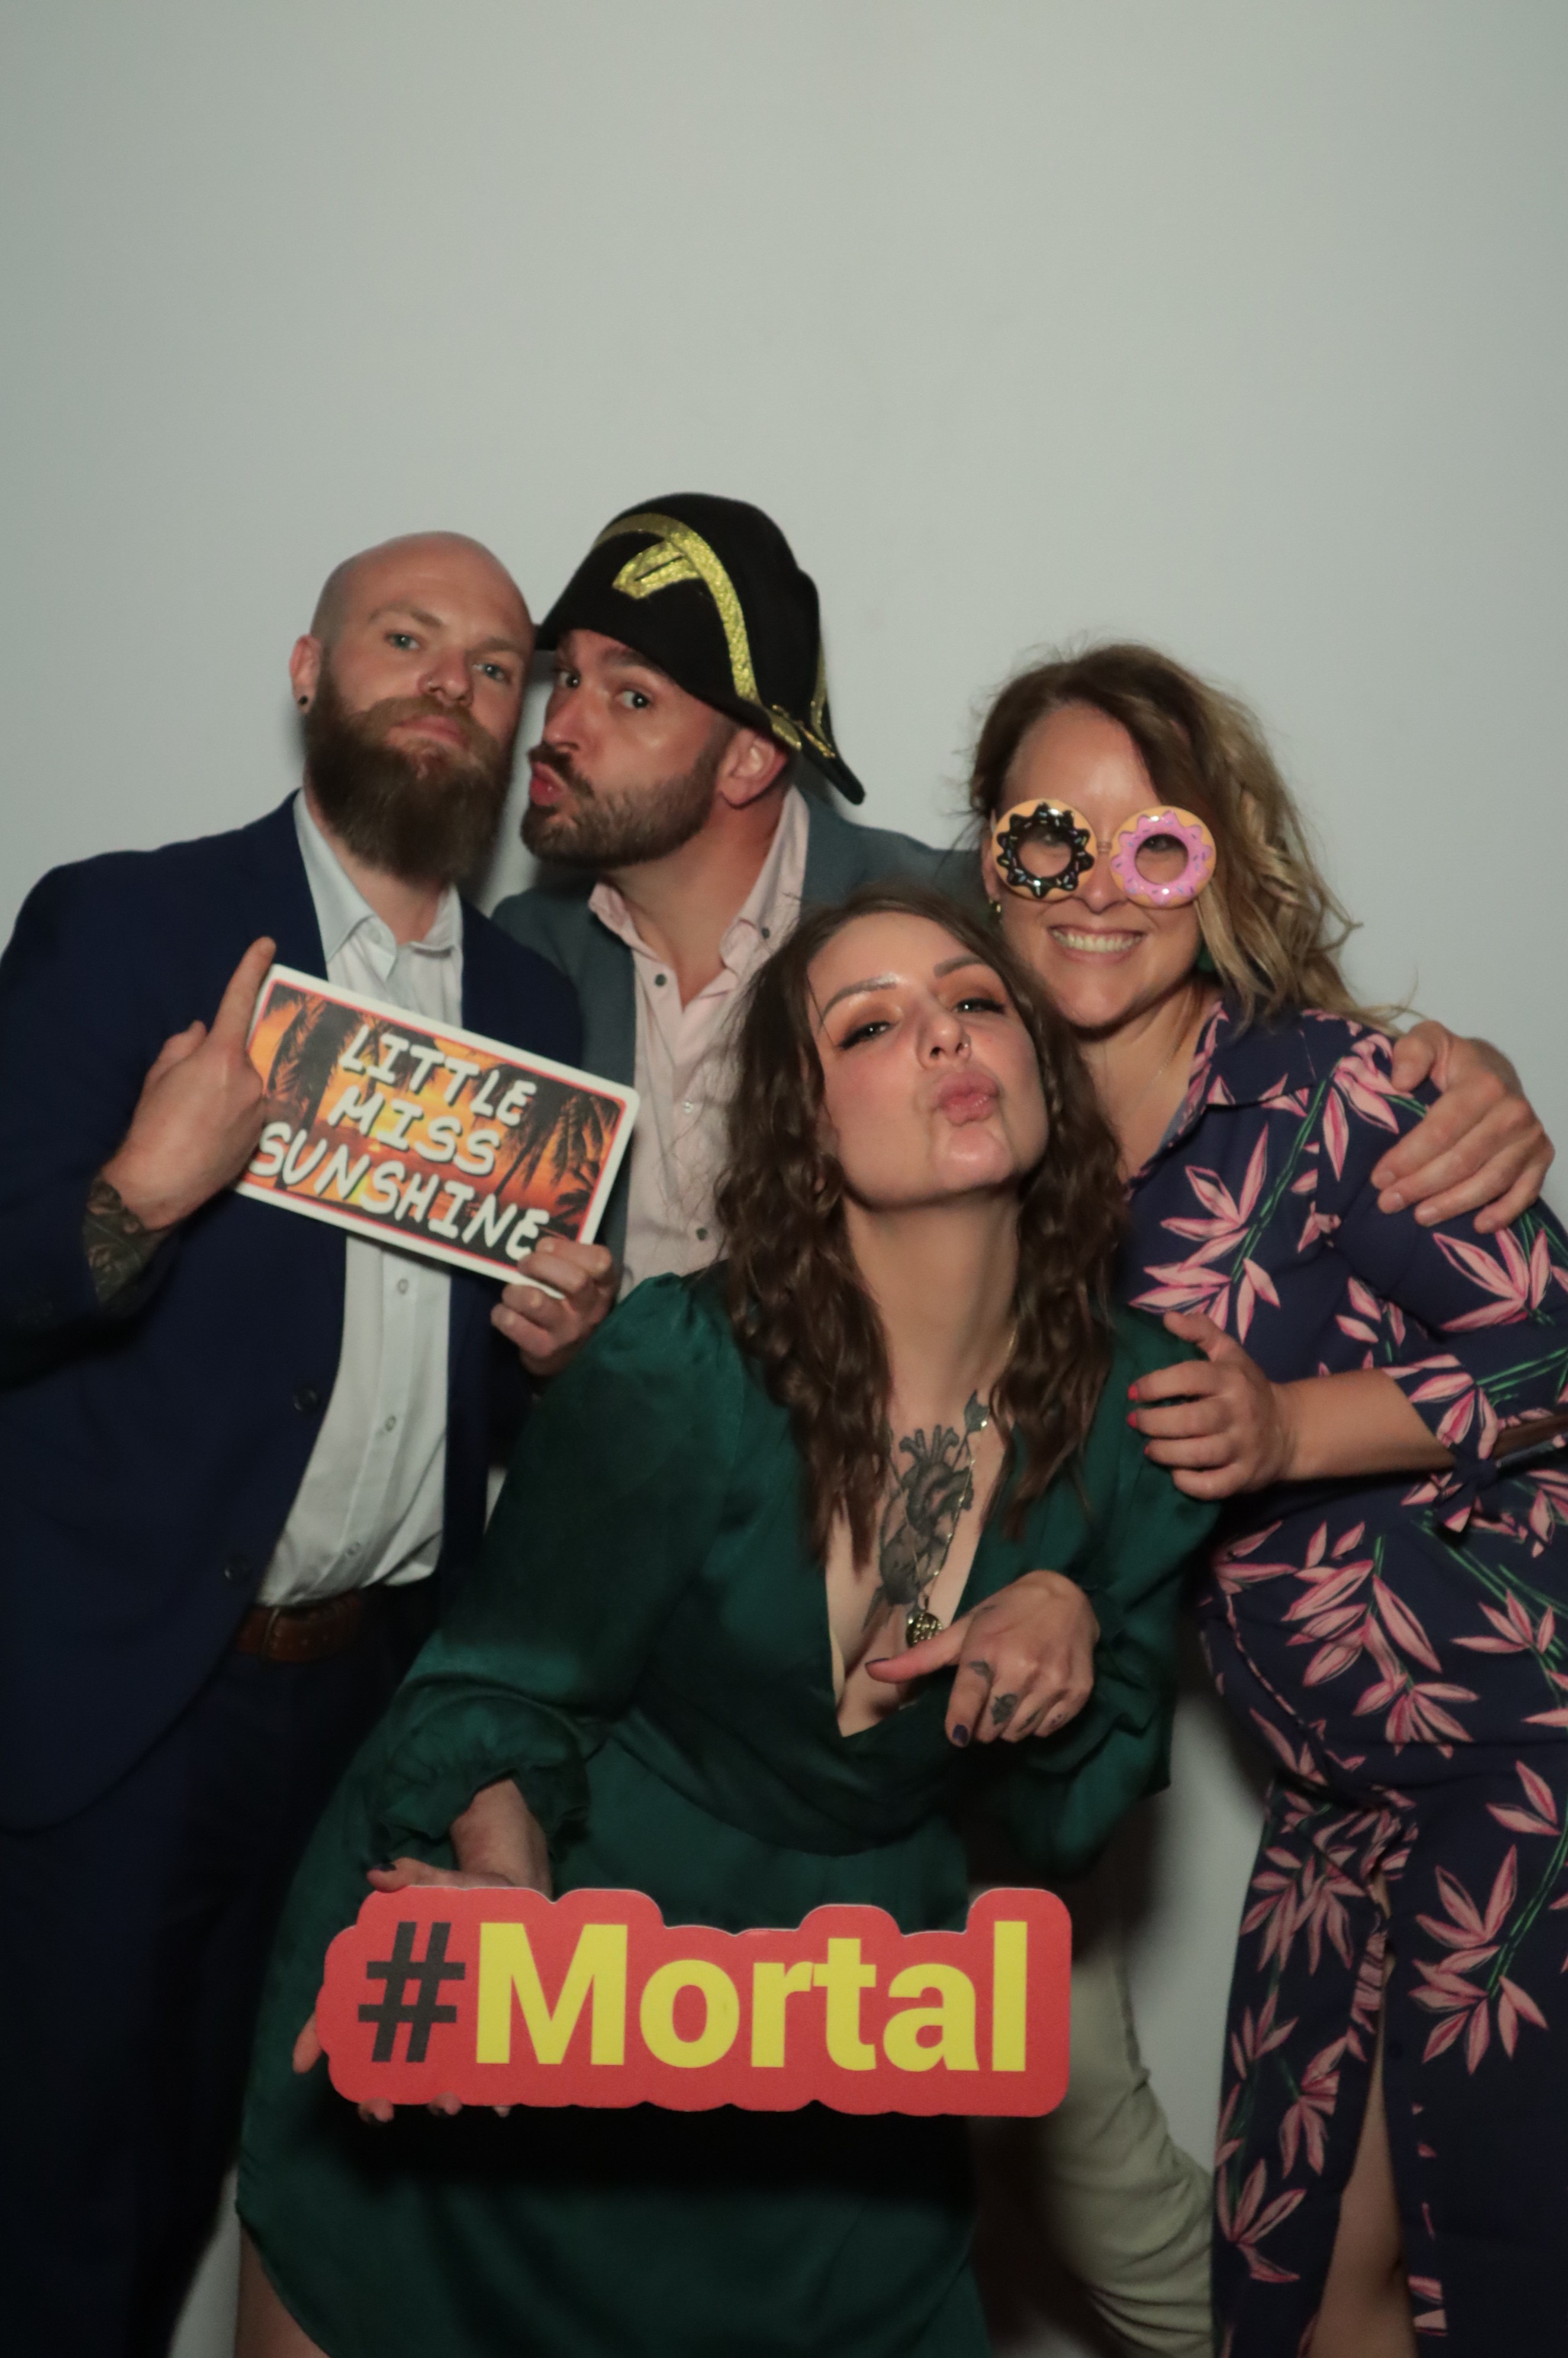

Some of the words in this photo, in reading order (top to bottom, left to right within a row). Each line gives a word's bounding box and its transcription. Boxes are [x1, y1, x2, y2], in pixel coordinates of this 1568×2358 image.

[329, 1085, 503, 1175] MISS
[339, 1025, 537, 1125] LITTLE
[249, 1122, 550, 1261] SUNSHINE
[358, 1921, 1028, 2072] #Mortal
